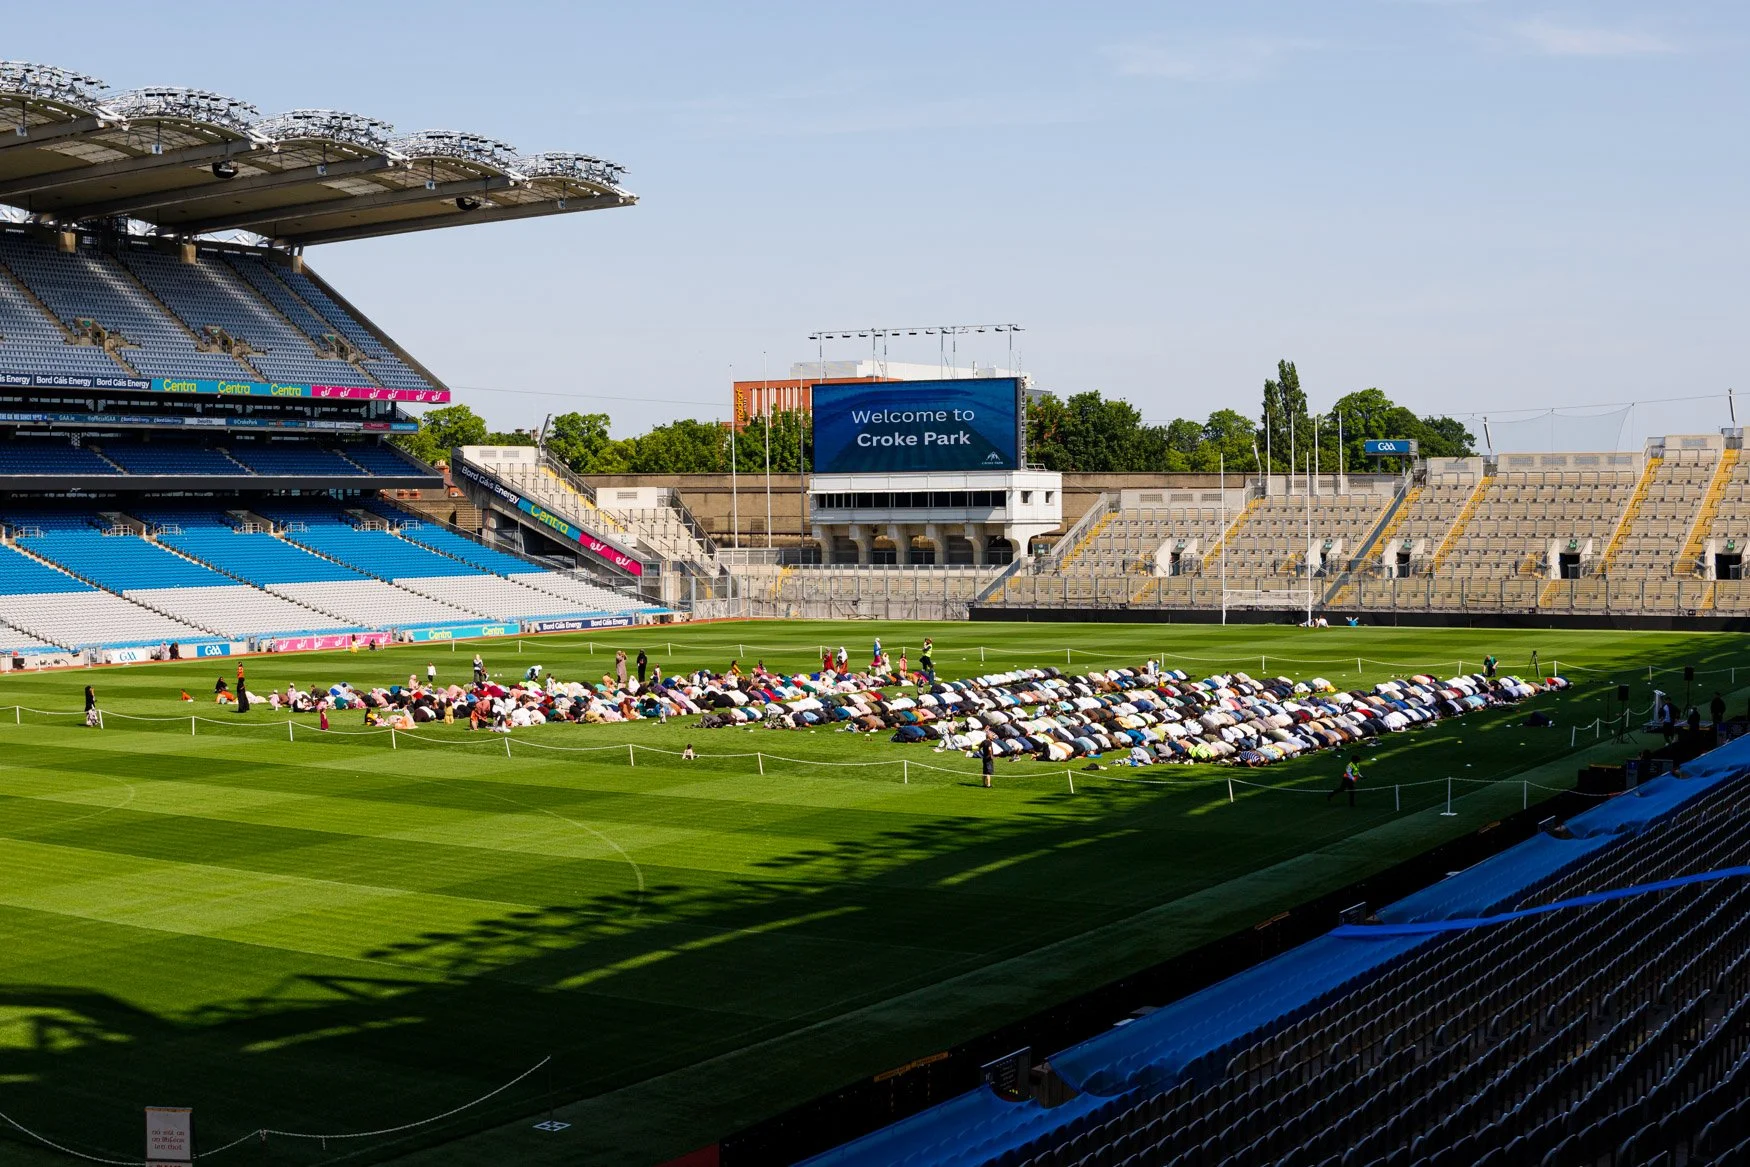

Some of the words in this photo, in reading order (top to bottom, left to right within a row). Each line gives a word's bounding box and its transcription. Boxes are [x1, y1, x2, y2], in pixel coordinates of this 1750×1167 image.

[6, 375, 30, 384] Energy
[54, 376, 68, 384] Gáis
[69, 378, 92, 386] Energy
[113, 378, 126, 387] Gáis
[128, 380, 150, 388] Energy
[164, 379, 196, 392] Centra
[218, 381, 250, 394] Centra
[271, 384, 301, 396] Centra
[852, 409, 947, 424] Welcome
[953, 408, 975, 421] to
[857, 432, 918, 446] Croke
[925, 431, 971, 445] Park
[1378, 442, 1396, 451] GAA
[462, 466, 480, 482] Bord
[479, 476, 494, 490] Gáis
[494, 484, 520, 504] Energy
[530, 504, 569, 534] Centra
[566, 621, 582, 630] Energy
[613, 618, 628, 626] Energy
[428, 629, 452, 640] Centra
[482, 626, 504, 636] Centra
[119, 651, 136, 661] GAA
[205, 645, 222, 656] GAA
